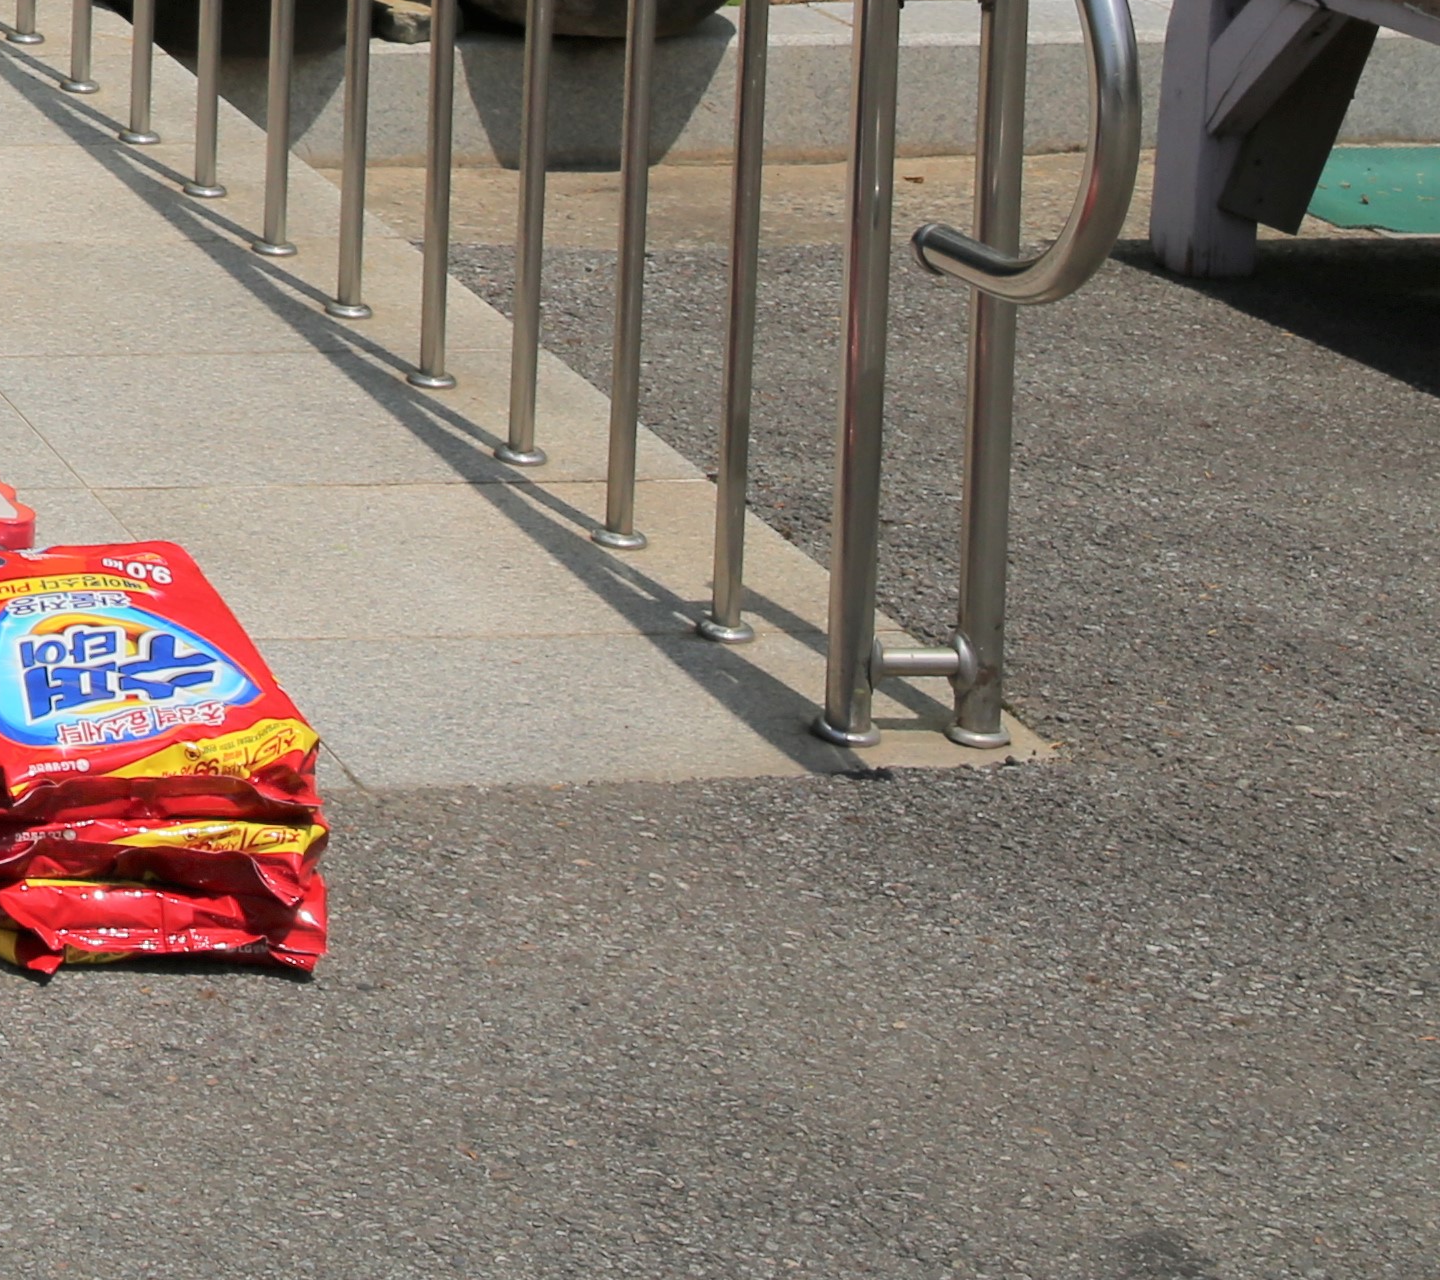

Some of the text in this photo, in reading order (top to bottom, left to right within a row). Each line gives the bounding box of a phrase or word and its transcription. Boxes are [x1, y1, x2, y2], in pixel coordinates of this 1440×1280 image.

[19, 630, 116, 665] 타이
[26, 633, 215, 719] 수퍼
[56, 711, 150, 746] 효소세탁
